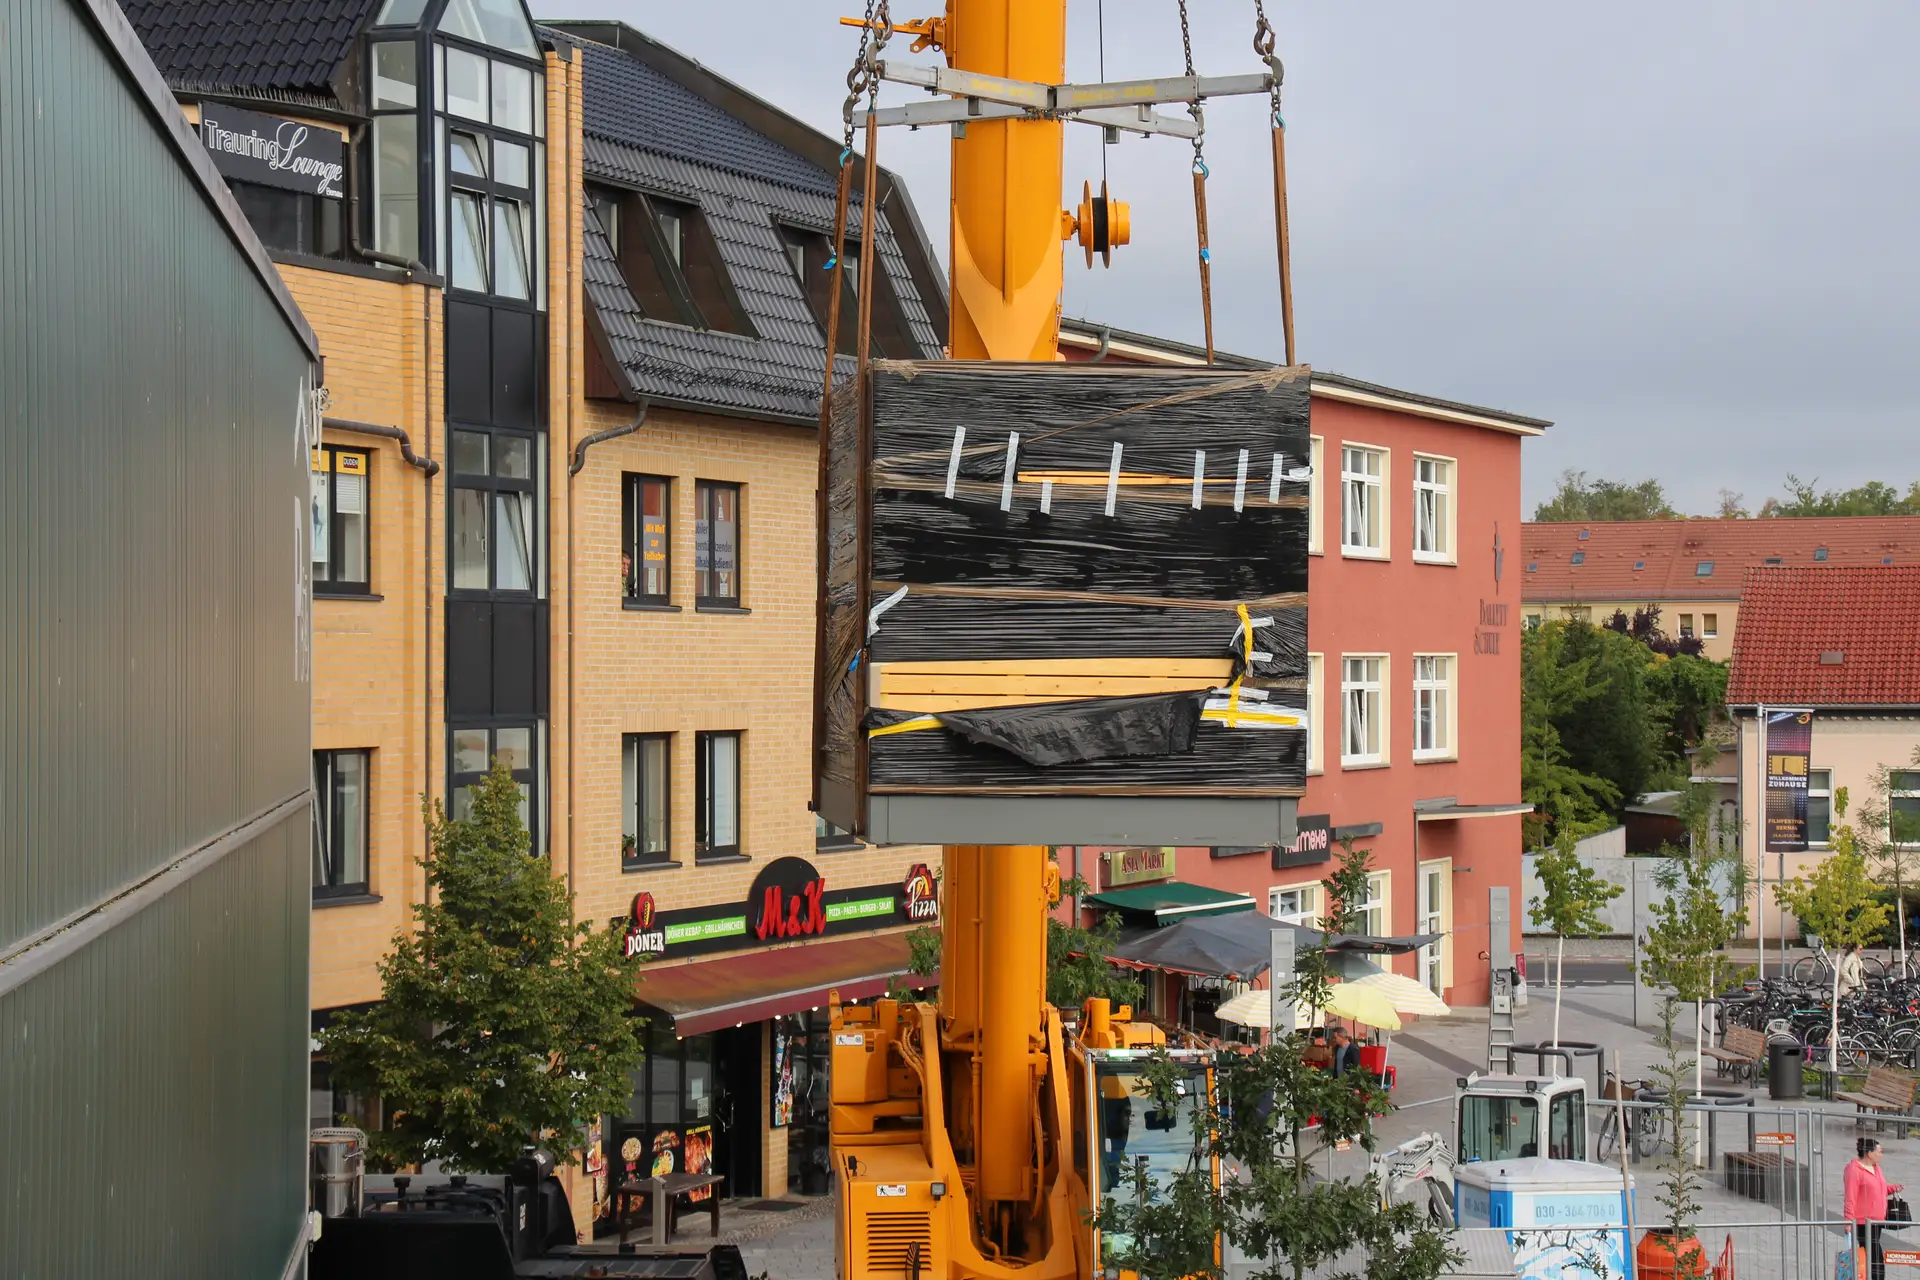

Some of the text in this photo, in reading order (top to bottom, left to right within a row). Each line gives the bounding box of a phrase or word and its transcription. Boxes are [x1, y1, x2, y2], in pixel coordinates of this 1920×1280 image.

[204, 119, 343, 194] Trauring Lounge
[1121, 851, 1166, 875] ASIA MARKT
[906, 875, 938, 919] Pizza
[828, 901, 892, 917] PIZZA PASTA BURGER SALAT
[627, 929, 665, 957] DÖNER
[666, 926, 685, 940] DÖNER
[1535, 1205, 1555, 1218] 030
[1886, 1252, 1917, 1261] HORNBACH
